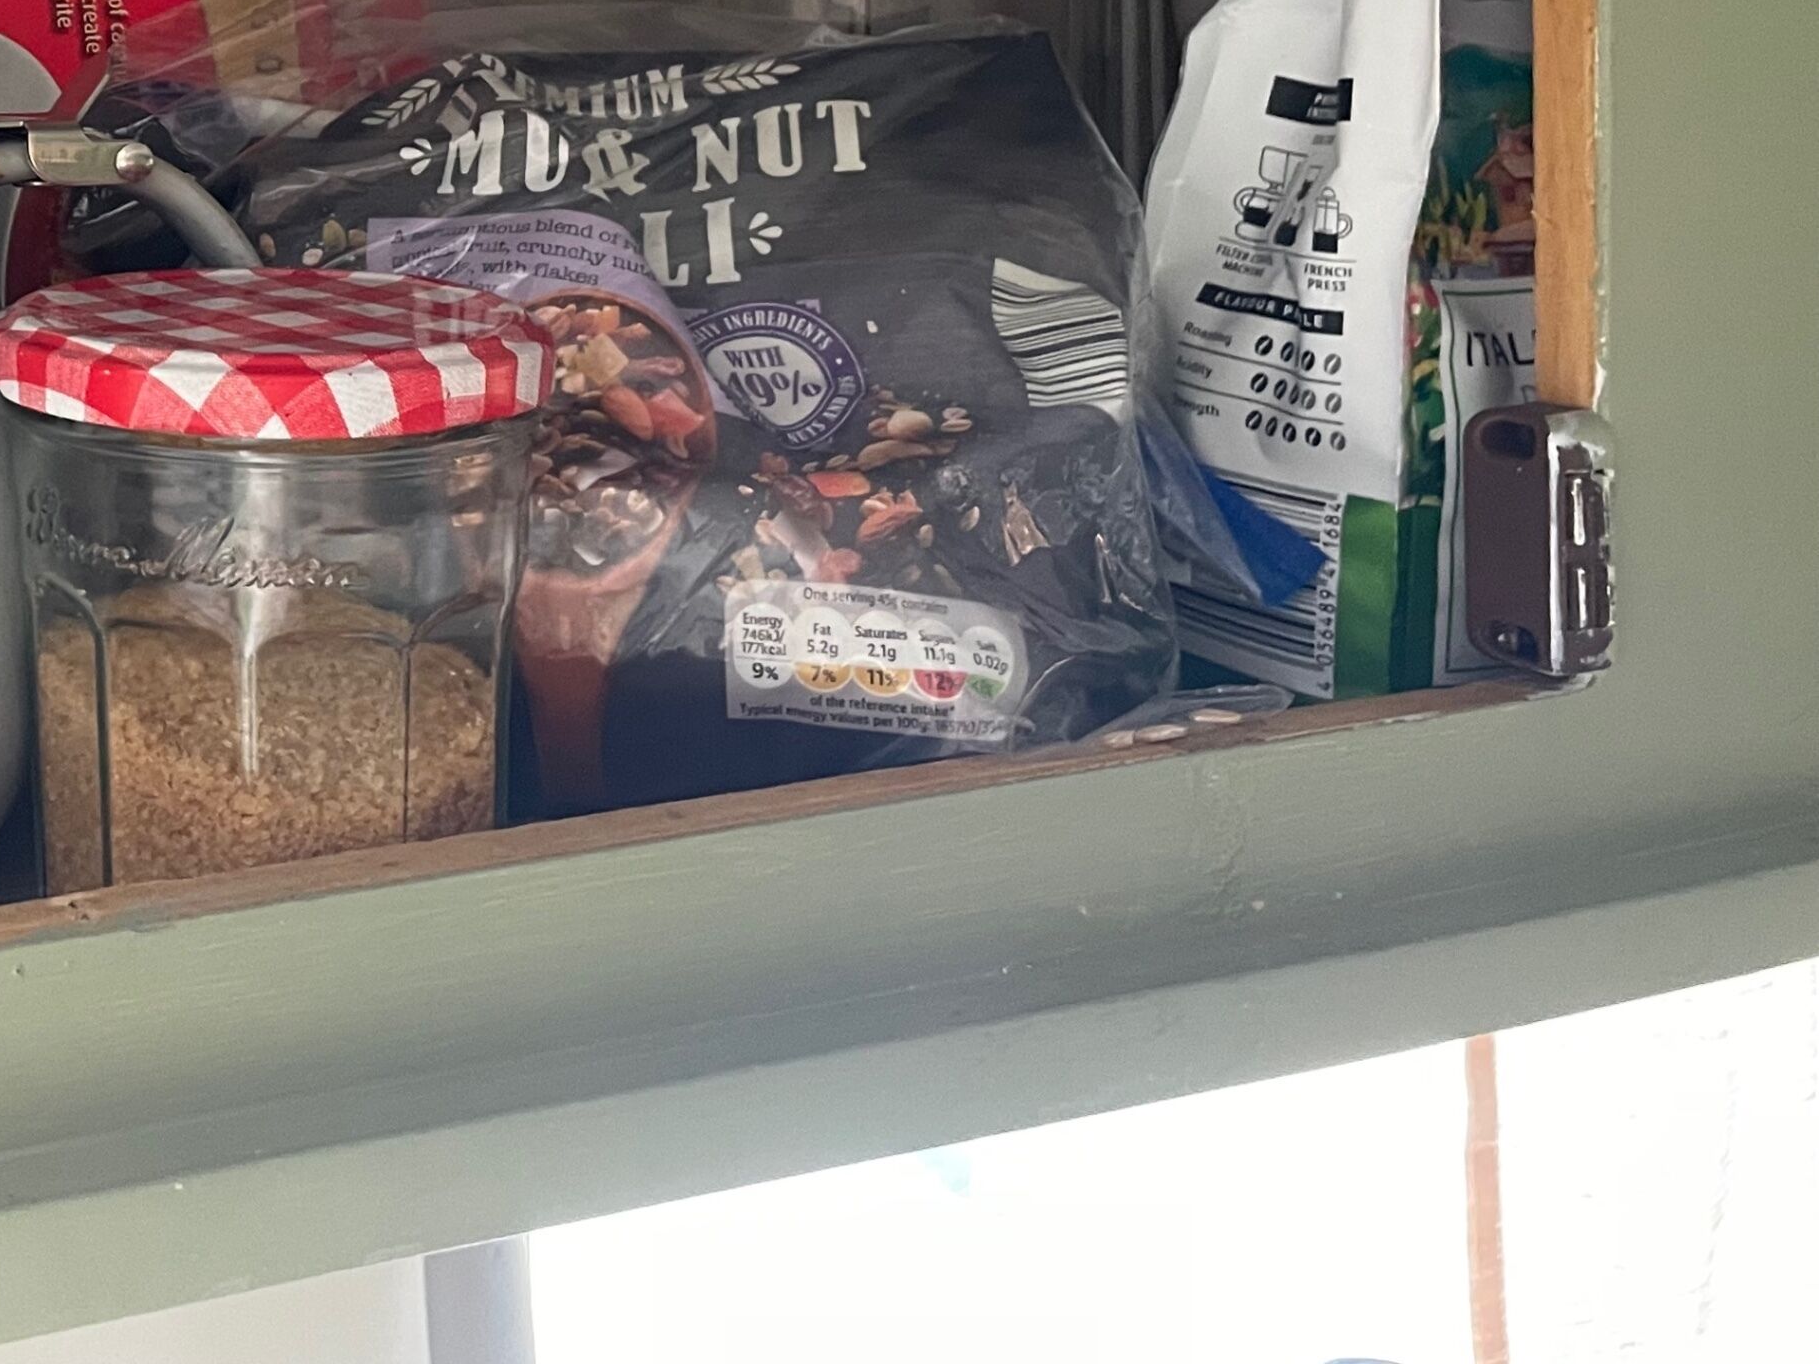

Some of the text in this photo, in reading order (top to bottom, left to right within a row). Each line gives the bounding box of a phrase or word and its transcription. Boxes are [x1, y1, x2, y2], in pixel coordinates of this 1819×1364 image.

[691, 99, 873, 193] NUT
[534, 219, 592, 239] blend
[598, 229, 620, 245] of
[516, 241, 607, 266] crunchy
[482, 259, 528, 274] with
[533, 262, 599, 286] flakes
[1303, 262, 1353, 278] FRENCH
[1307, 278, 1347, 292] PRESS
[1214, 291, 1276, 313] FLAVOUR
[723, 309, 834, 351] INGREDIENTS
[723, 345, 786, 369] WITH
[1466, 329, 1536, 367] ITAL
[803, 587, 829, 602] One
[831, 590, 876, 609] serving
[742, 612, 784, 629] Energy
[813, 622, 832, 637] Fat
[854, 625, 908, 641] Saturates
[806, 639, 839, 658] 5.2g
[867, 643, 897, 662] 2.1g
[924, 646, 956, 665] 11.1g
[751, 662, 780, 681] 9%
[972, 651, 1009, 676] 0.02g
[810, 666, 837, 684] 7%
[810, 694, 825, 707] of
[826, 696, 846, 709] the
[849, 697, 907, 715] reference
